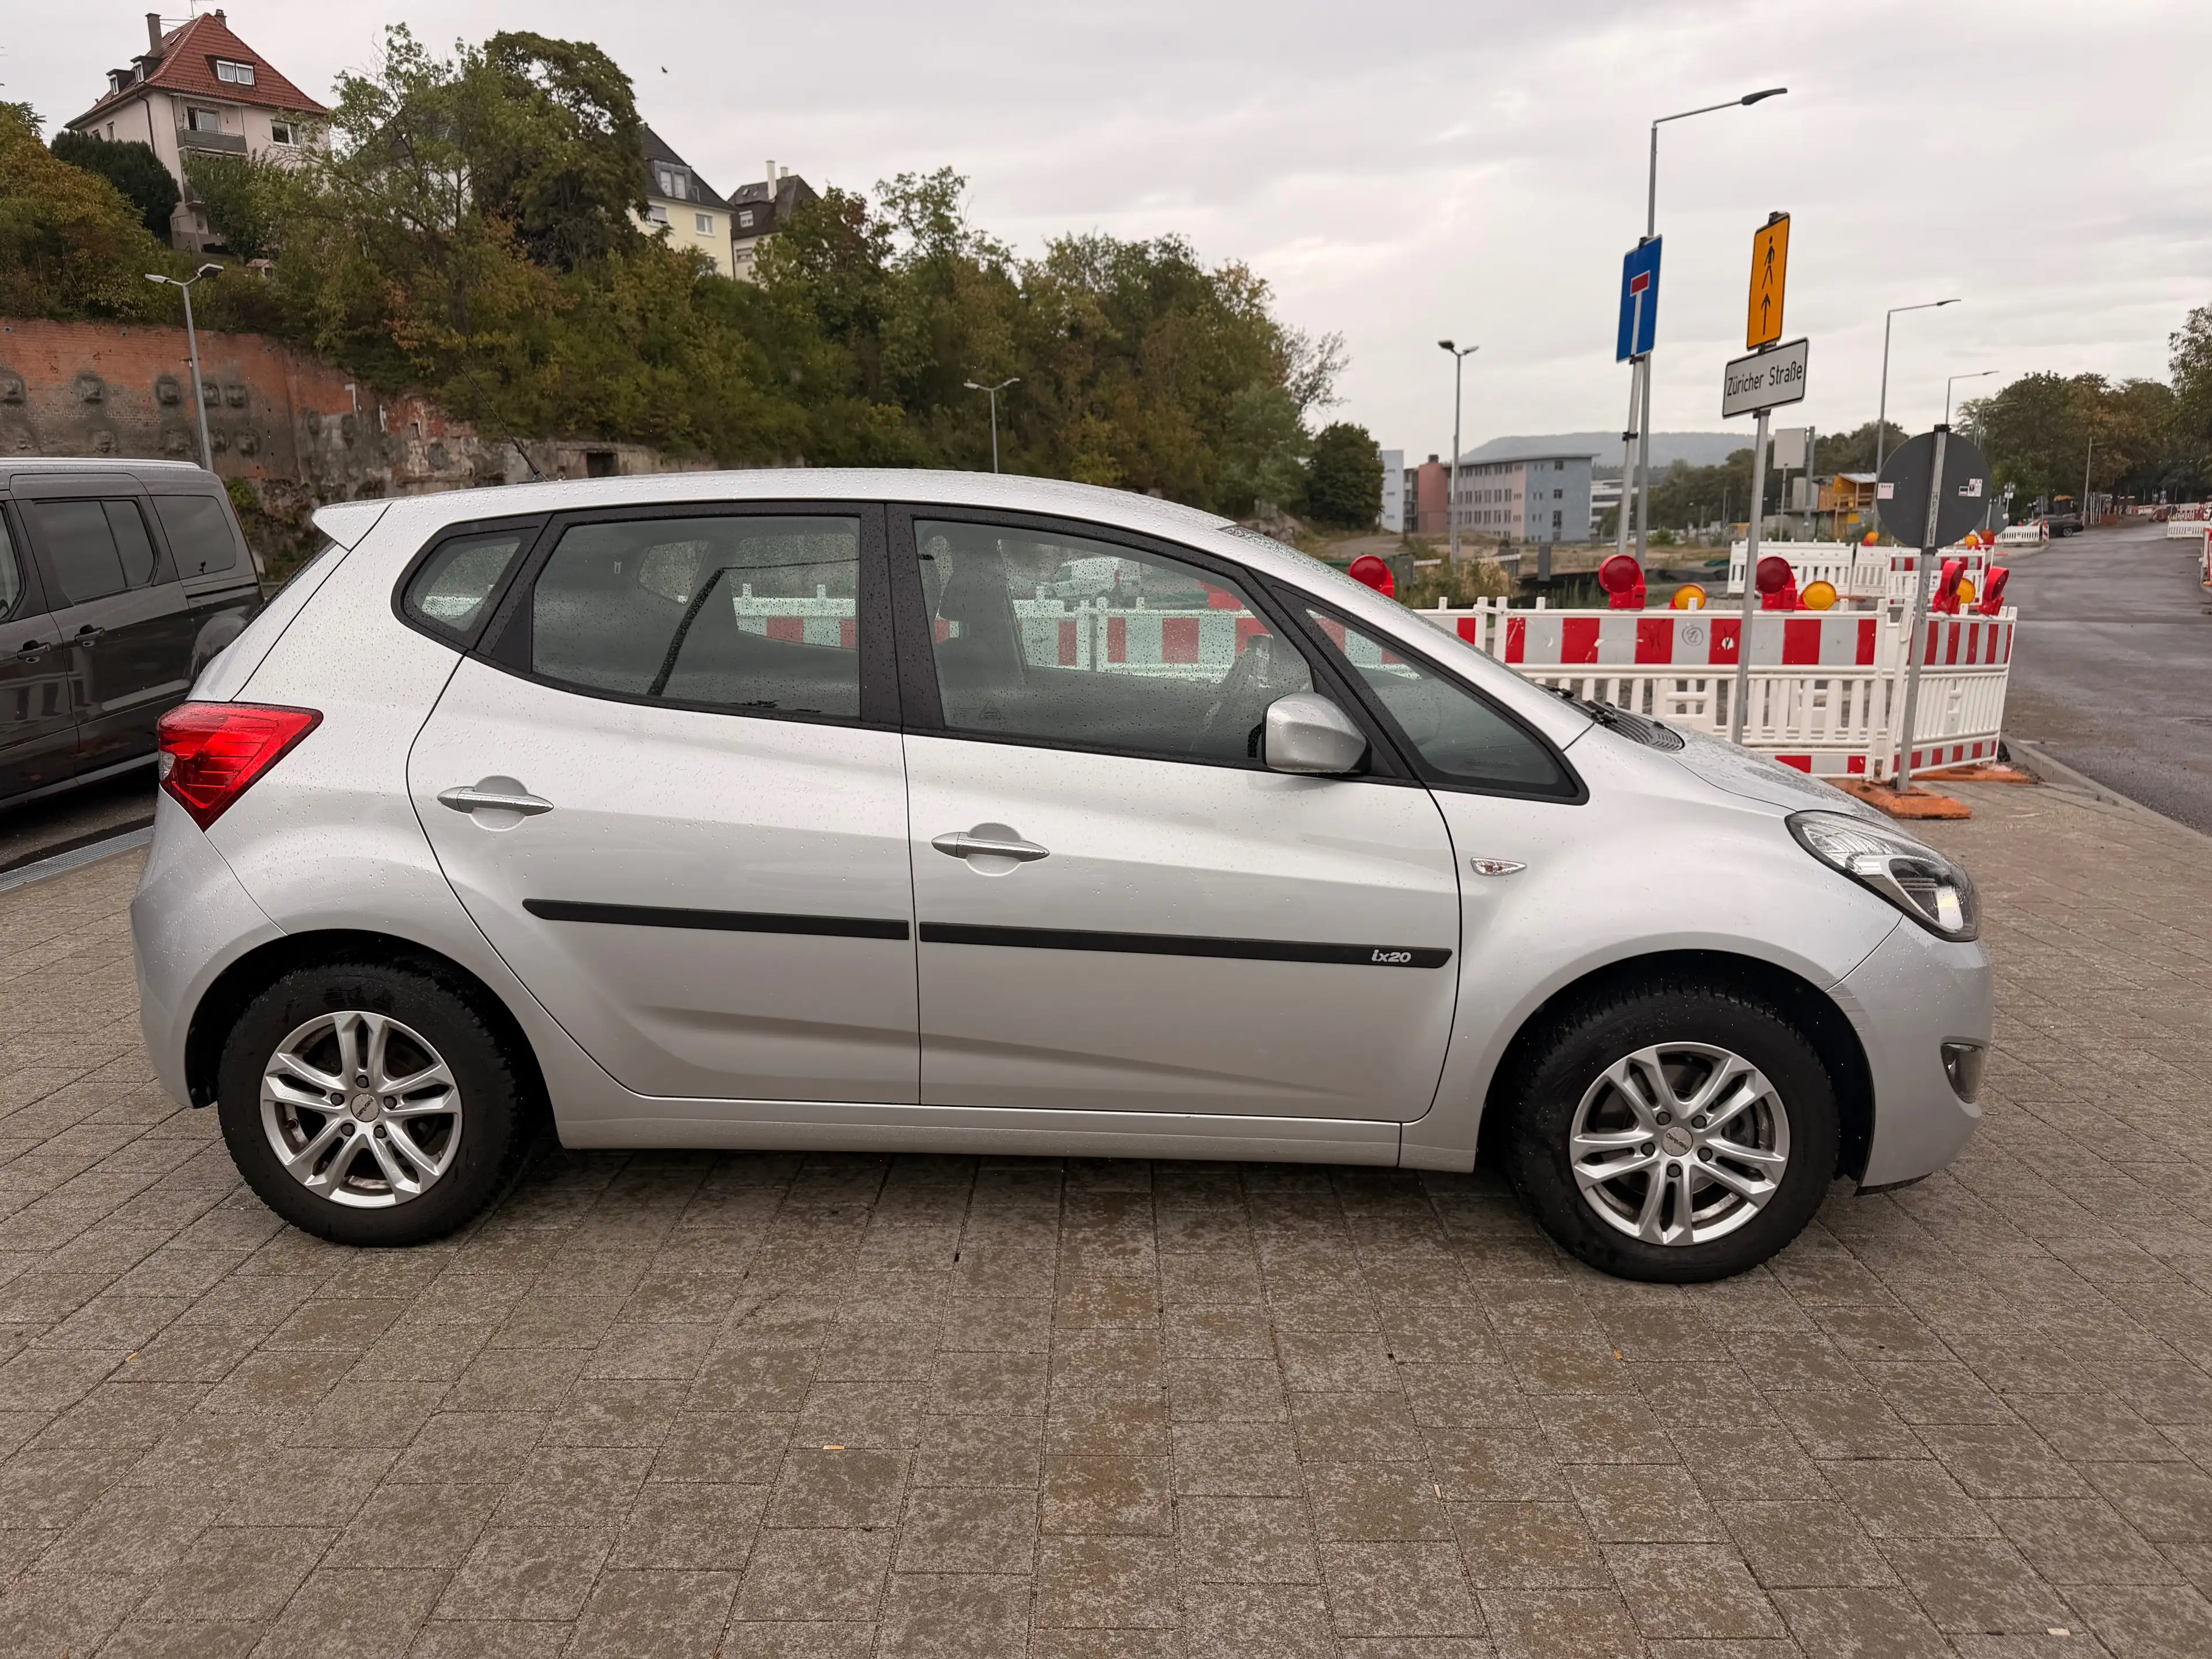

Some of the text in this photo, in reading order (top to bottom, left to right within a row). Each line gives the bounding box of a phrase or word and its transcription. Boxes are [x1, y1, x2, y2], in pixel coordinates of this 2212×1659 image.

[1727, 361, 1802, 396] Züricher Straße
[1372, 949, 1411, 963] ix20
